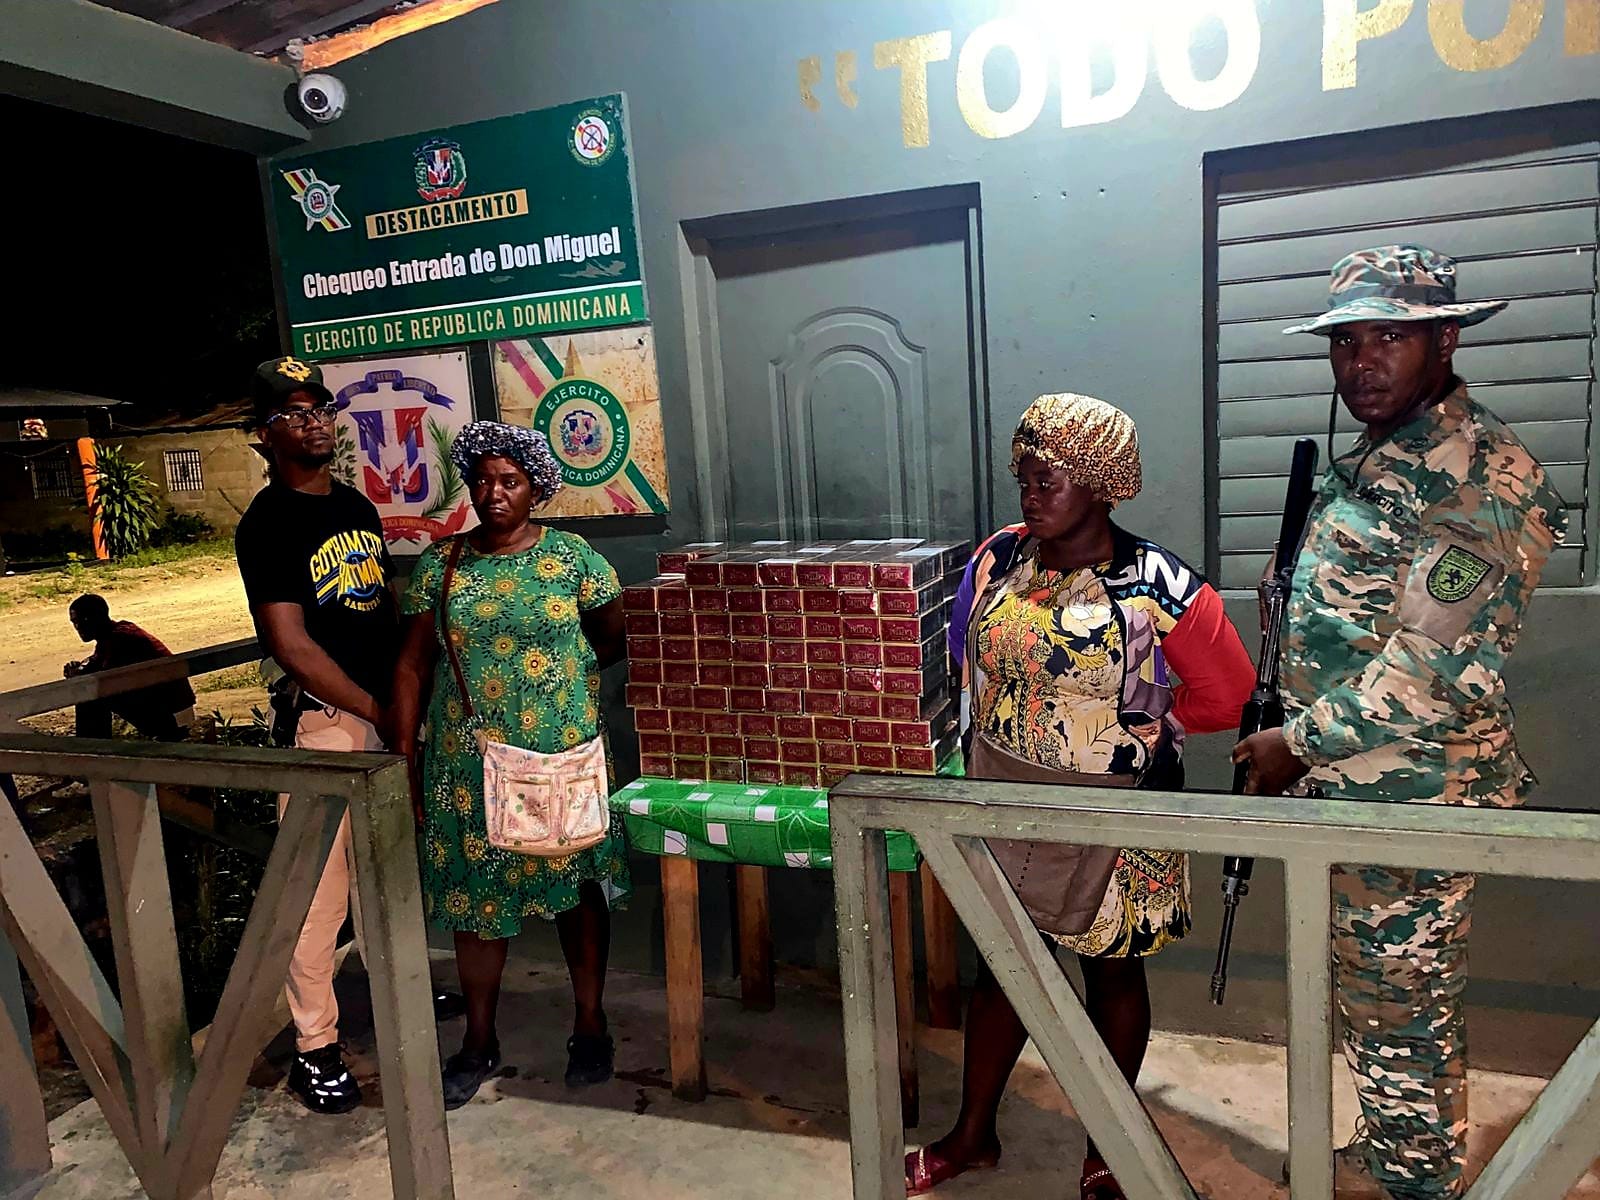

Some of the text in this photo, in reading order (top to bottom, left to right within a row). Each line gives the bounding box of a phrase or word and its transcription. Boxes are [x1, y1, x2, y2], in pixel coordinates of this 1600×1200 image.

[1321, 0, 1600, 92] PO
[375, 192, 518, 236] DESTACAMENTO
[303, 227, 621, 299] Chequeo Entrada de Don Miguel
[303, 292, 632, 353] EJERCITO DE REPUBLICA DOMINICANA
[546, 385, 610, 411] EJERCITO
[585, 425, 625, 481] DOMINICANA
[310, 530, 366, 582] GOTHAM
